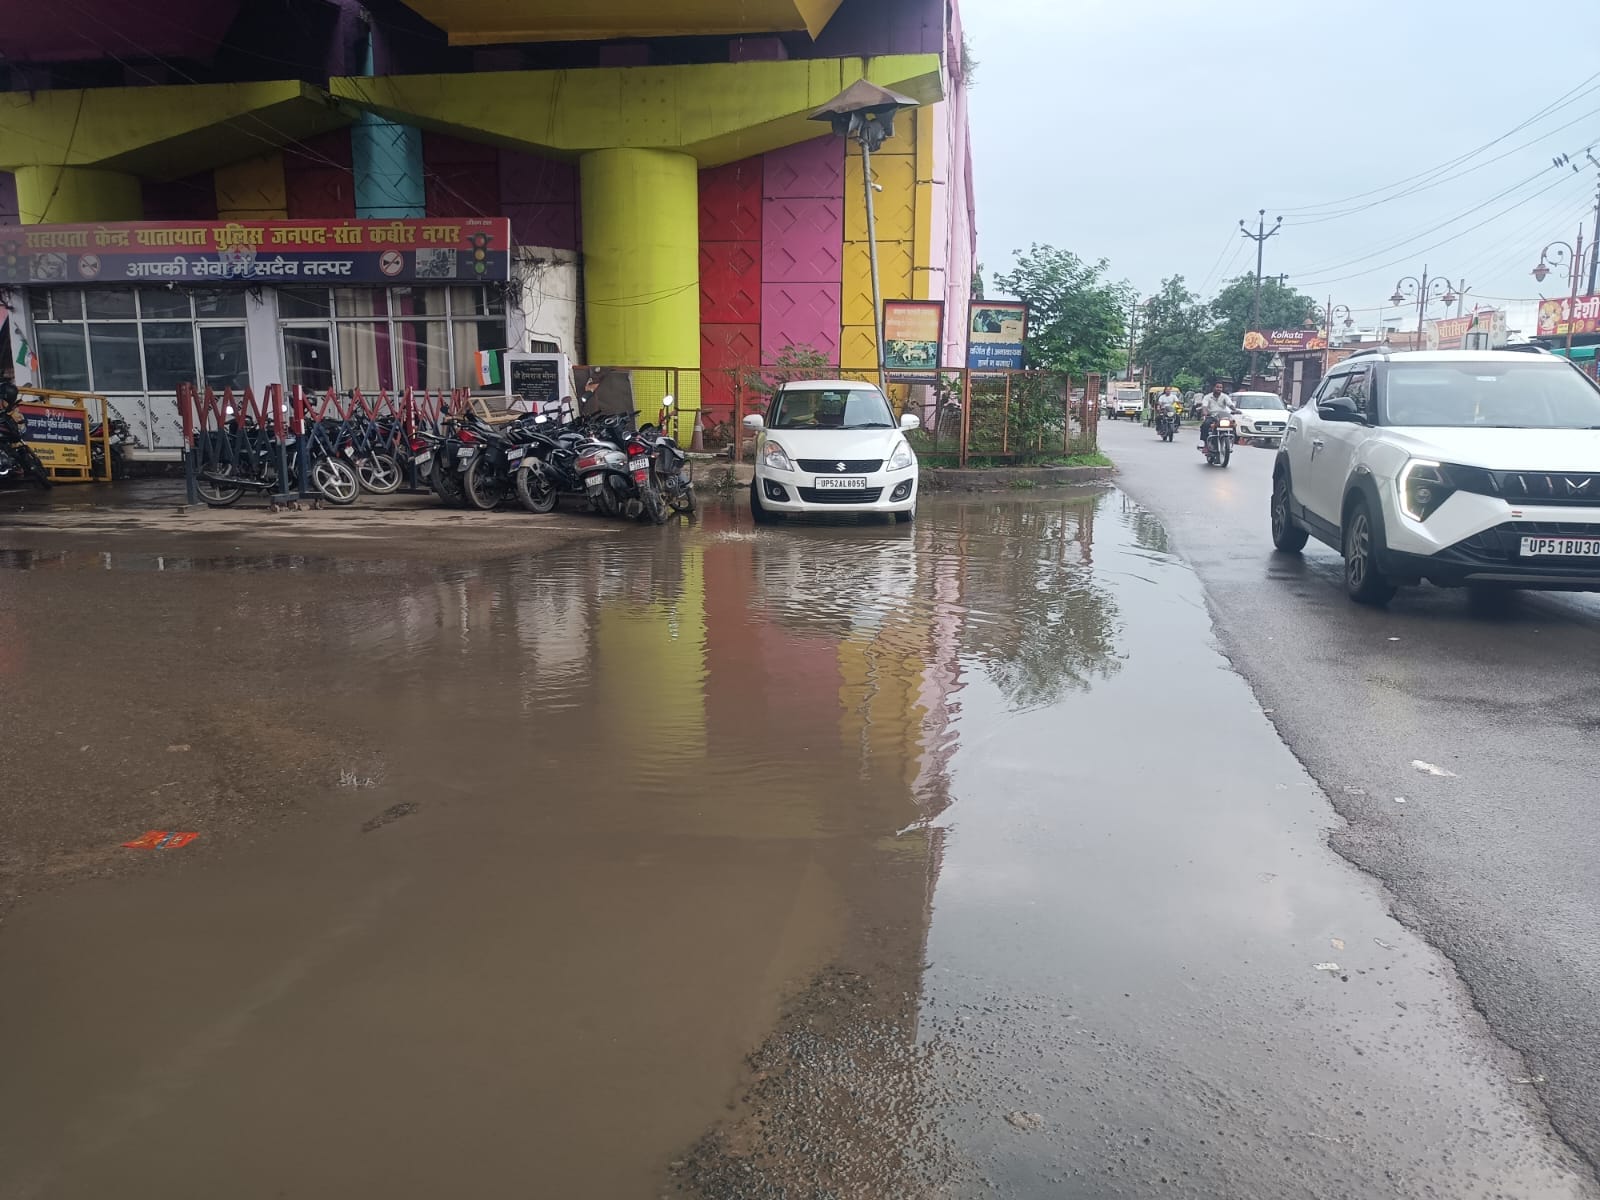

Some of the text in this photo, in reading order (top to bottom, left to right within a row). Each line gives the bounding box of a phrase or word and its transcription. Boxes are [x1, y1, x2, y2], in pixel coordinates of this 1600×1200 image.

[26, 222, 462, 250] सहायता केन्द्र यातायात पुलिस जनपद-संत कबीर नगर
[126, 256, 354, 277] आपकी सेवा में सदैव तत्पर
[1271, 330, 1303, 339] Kolkata
[821, 480, 865, 488] UP52AL8055
[1529, 539, 1600, 555] UP51BU30
